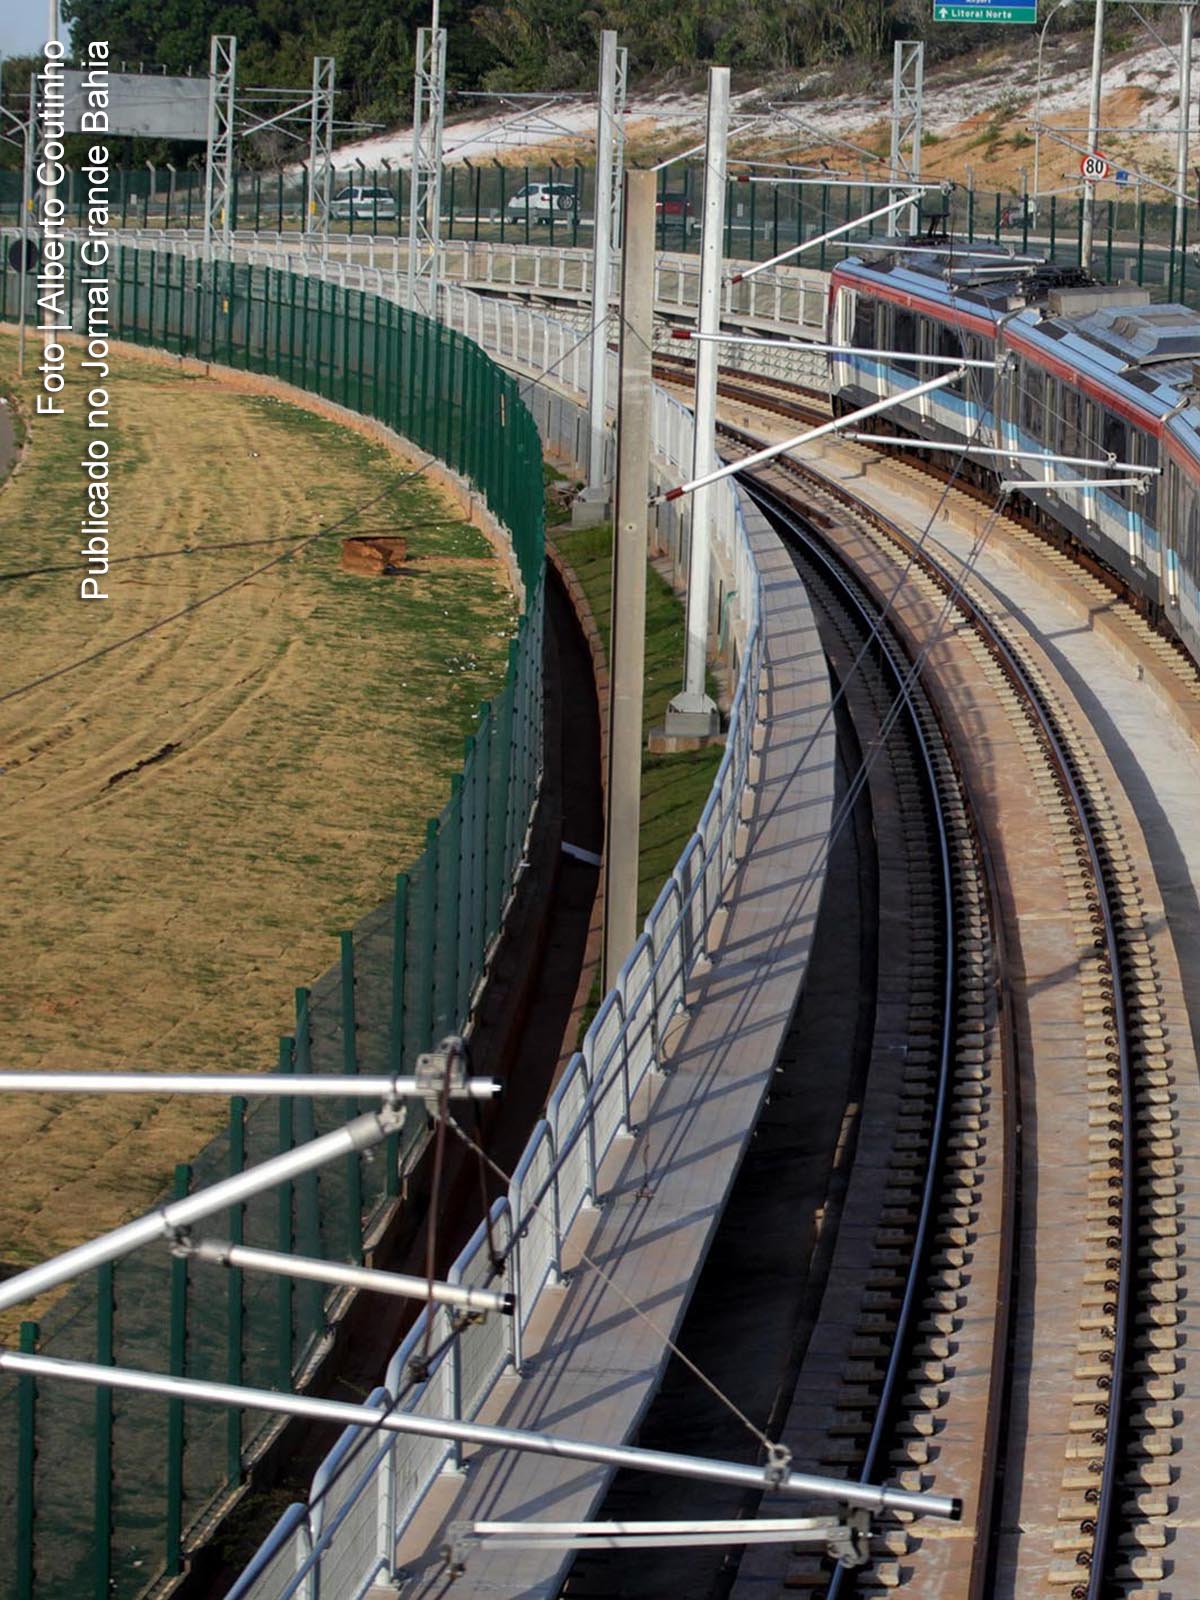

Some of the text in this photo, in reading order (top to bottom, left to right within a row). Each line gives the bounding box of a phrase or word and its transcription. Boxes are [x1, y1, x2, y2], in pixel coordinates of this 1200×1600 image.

[951, 9, 1012, 19] Litoral Norte
[1086, 159, 1104, 174] 80
